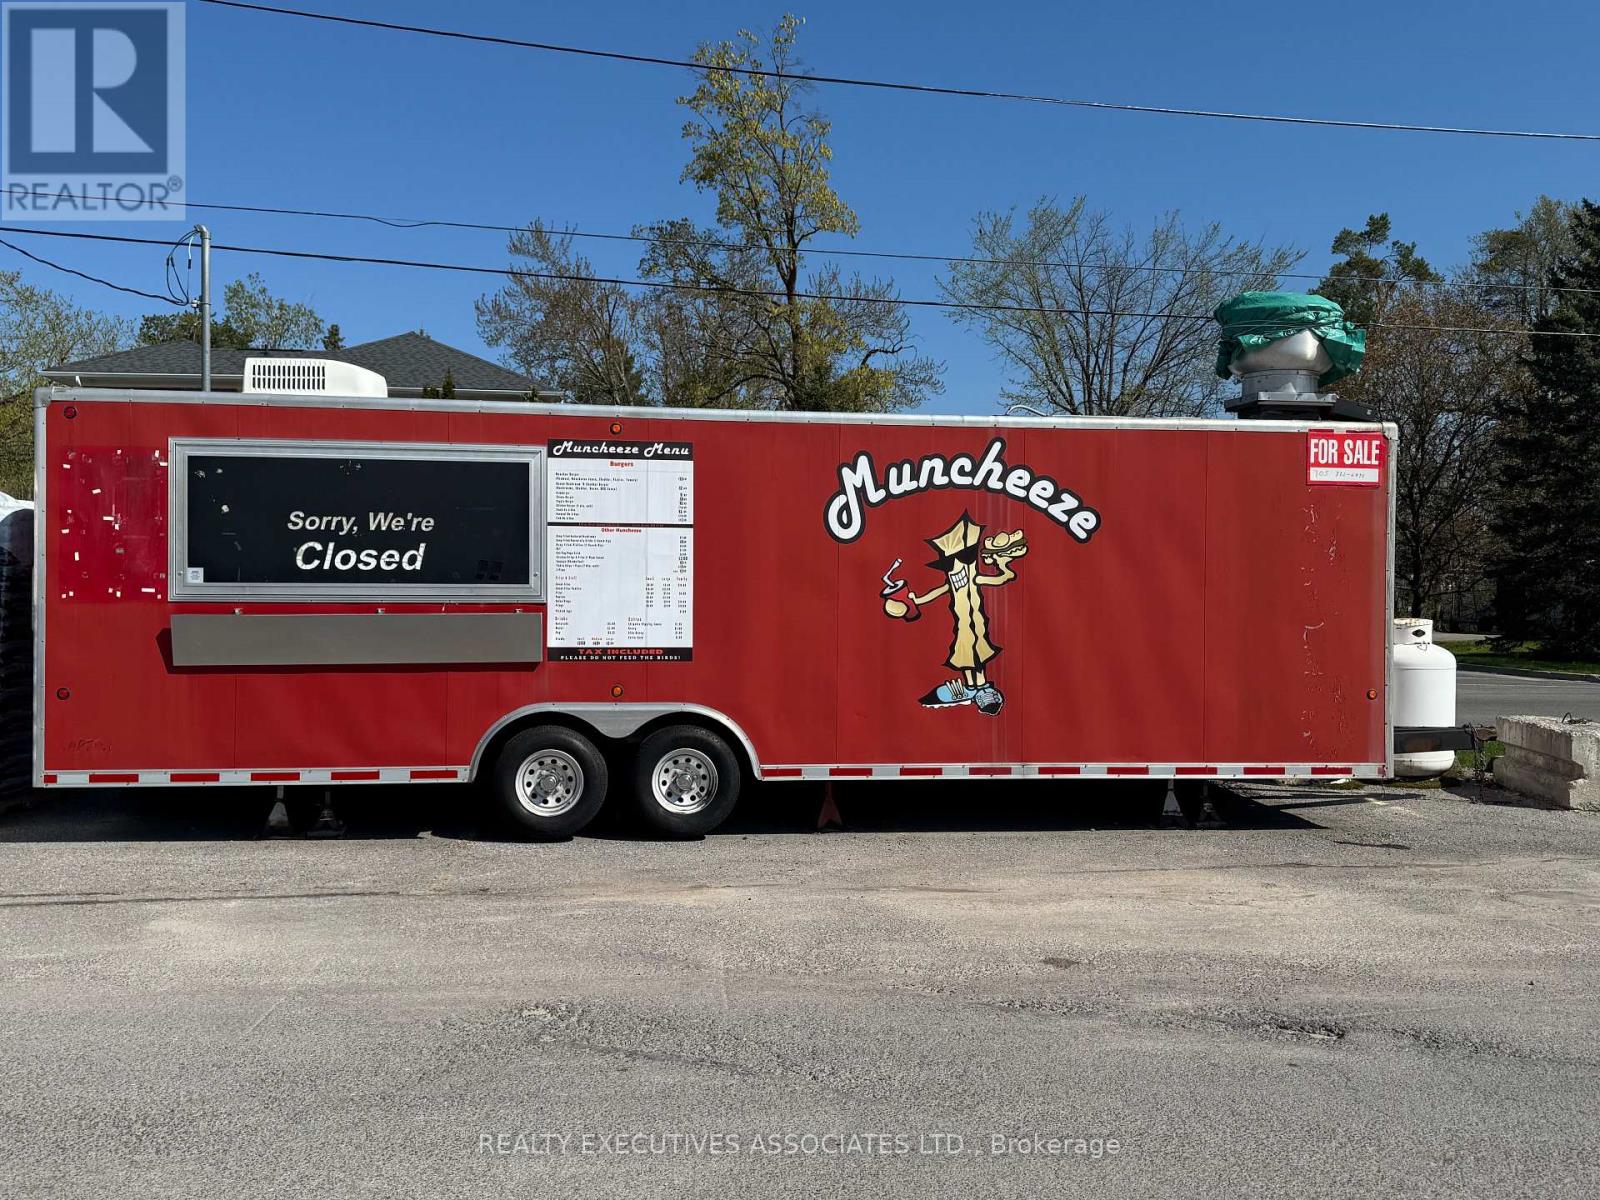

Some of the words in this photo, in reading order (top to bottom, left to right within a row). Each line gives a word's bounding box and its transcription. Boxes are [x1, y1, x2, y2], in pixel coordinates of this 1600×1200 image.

[553, 441, 639, 455] Muncheeze
[644, 443, 689, 457] Menu
[1310, 438, 1339, 464] FOR
[1343, 438, 1380, 465] SALE
[826, 440, 1099, 541] Muncheeze
[287, 510, 359, 536] Sorry,
[368, 511, 436, 532] We're
[295, 541, 427, 571] Closed
